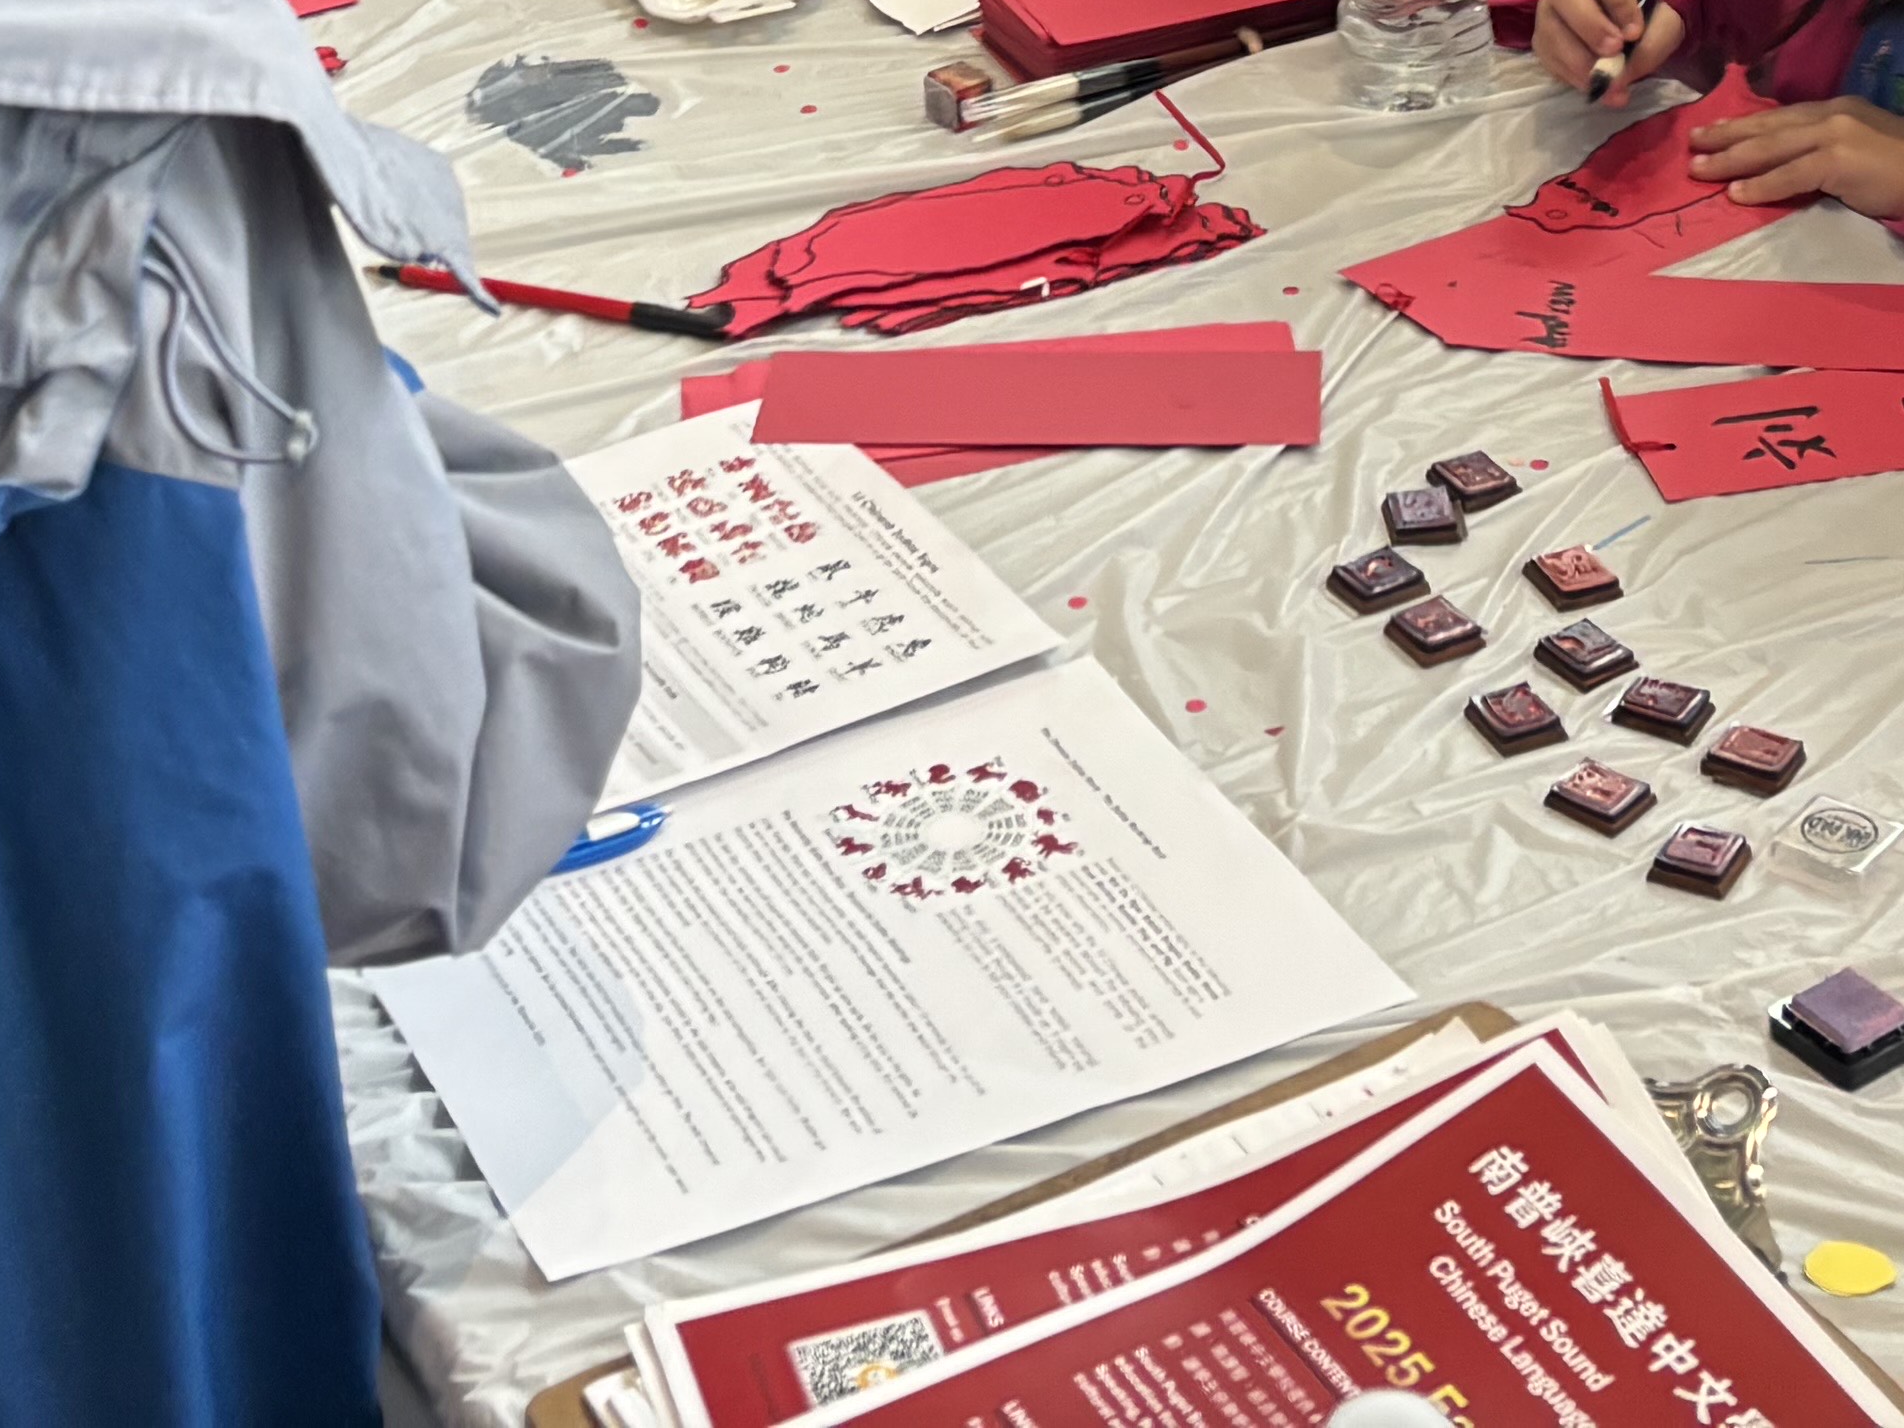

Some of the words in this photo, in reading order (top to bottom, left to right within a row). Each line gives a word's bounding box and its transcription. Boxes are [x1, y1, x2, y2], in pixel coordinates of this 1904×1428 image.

[1259, 1288, 1311, 1341] COURSE
[1320, 1284, 1435, 1386] 2025
[1429, 1255, 1509, 1341] Chinese
[1433, 1199, 1497, 1268] South
[1486, 1259, 1550, 1327] Puget
[1539, 1317, 1615, 1391] Sound
